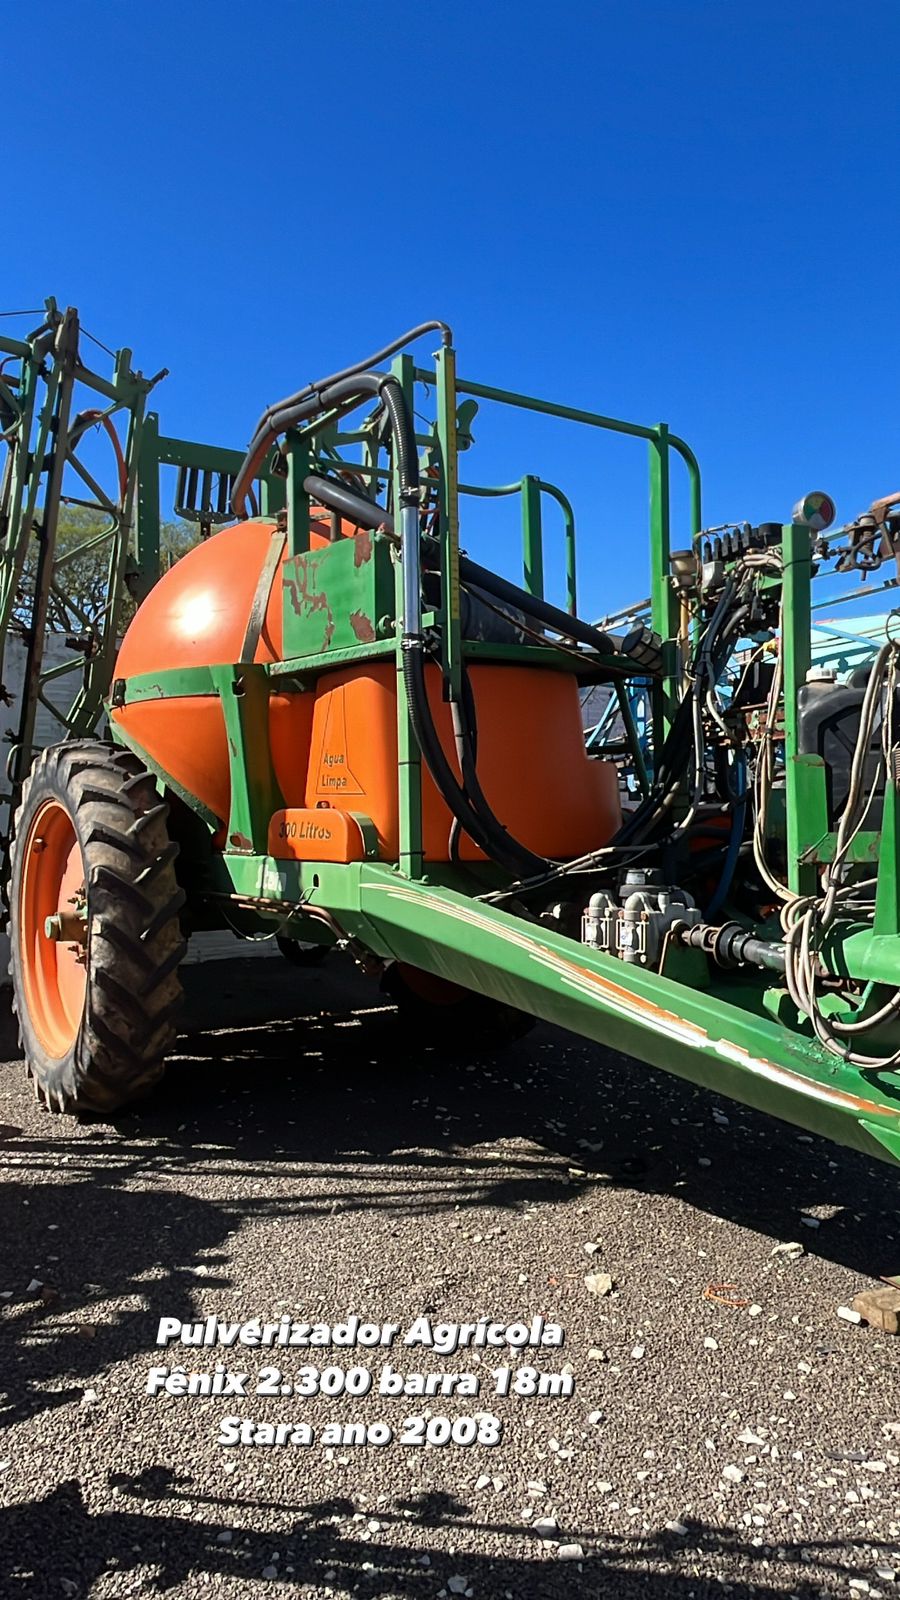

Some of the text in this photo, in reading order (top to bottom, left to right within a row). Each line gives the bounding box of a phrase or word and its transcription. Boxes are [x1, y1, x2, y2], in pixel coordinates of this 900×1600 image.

[321, 774, 347, 790] Limpa
[279, 821, 332, 839] 300 Litros
